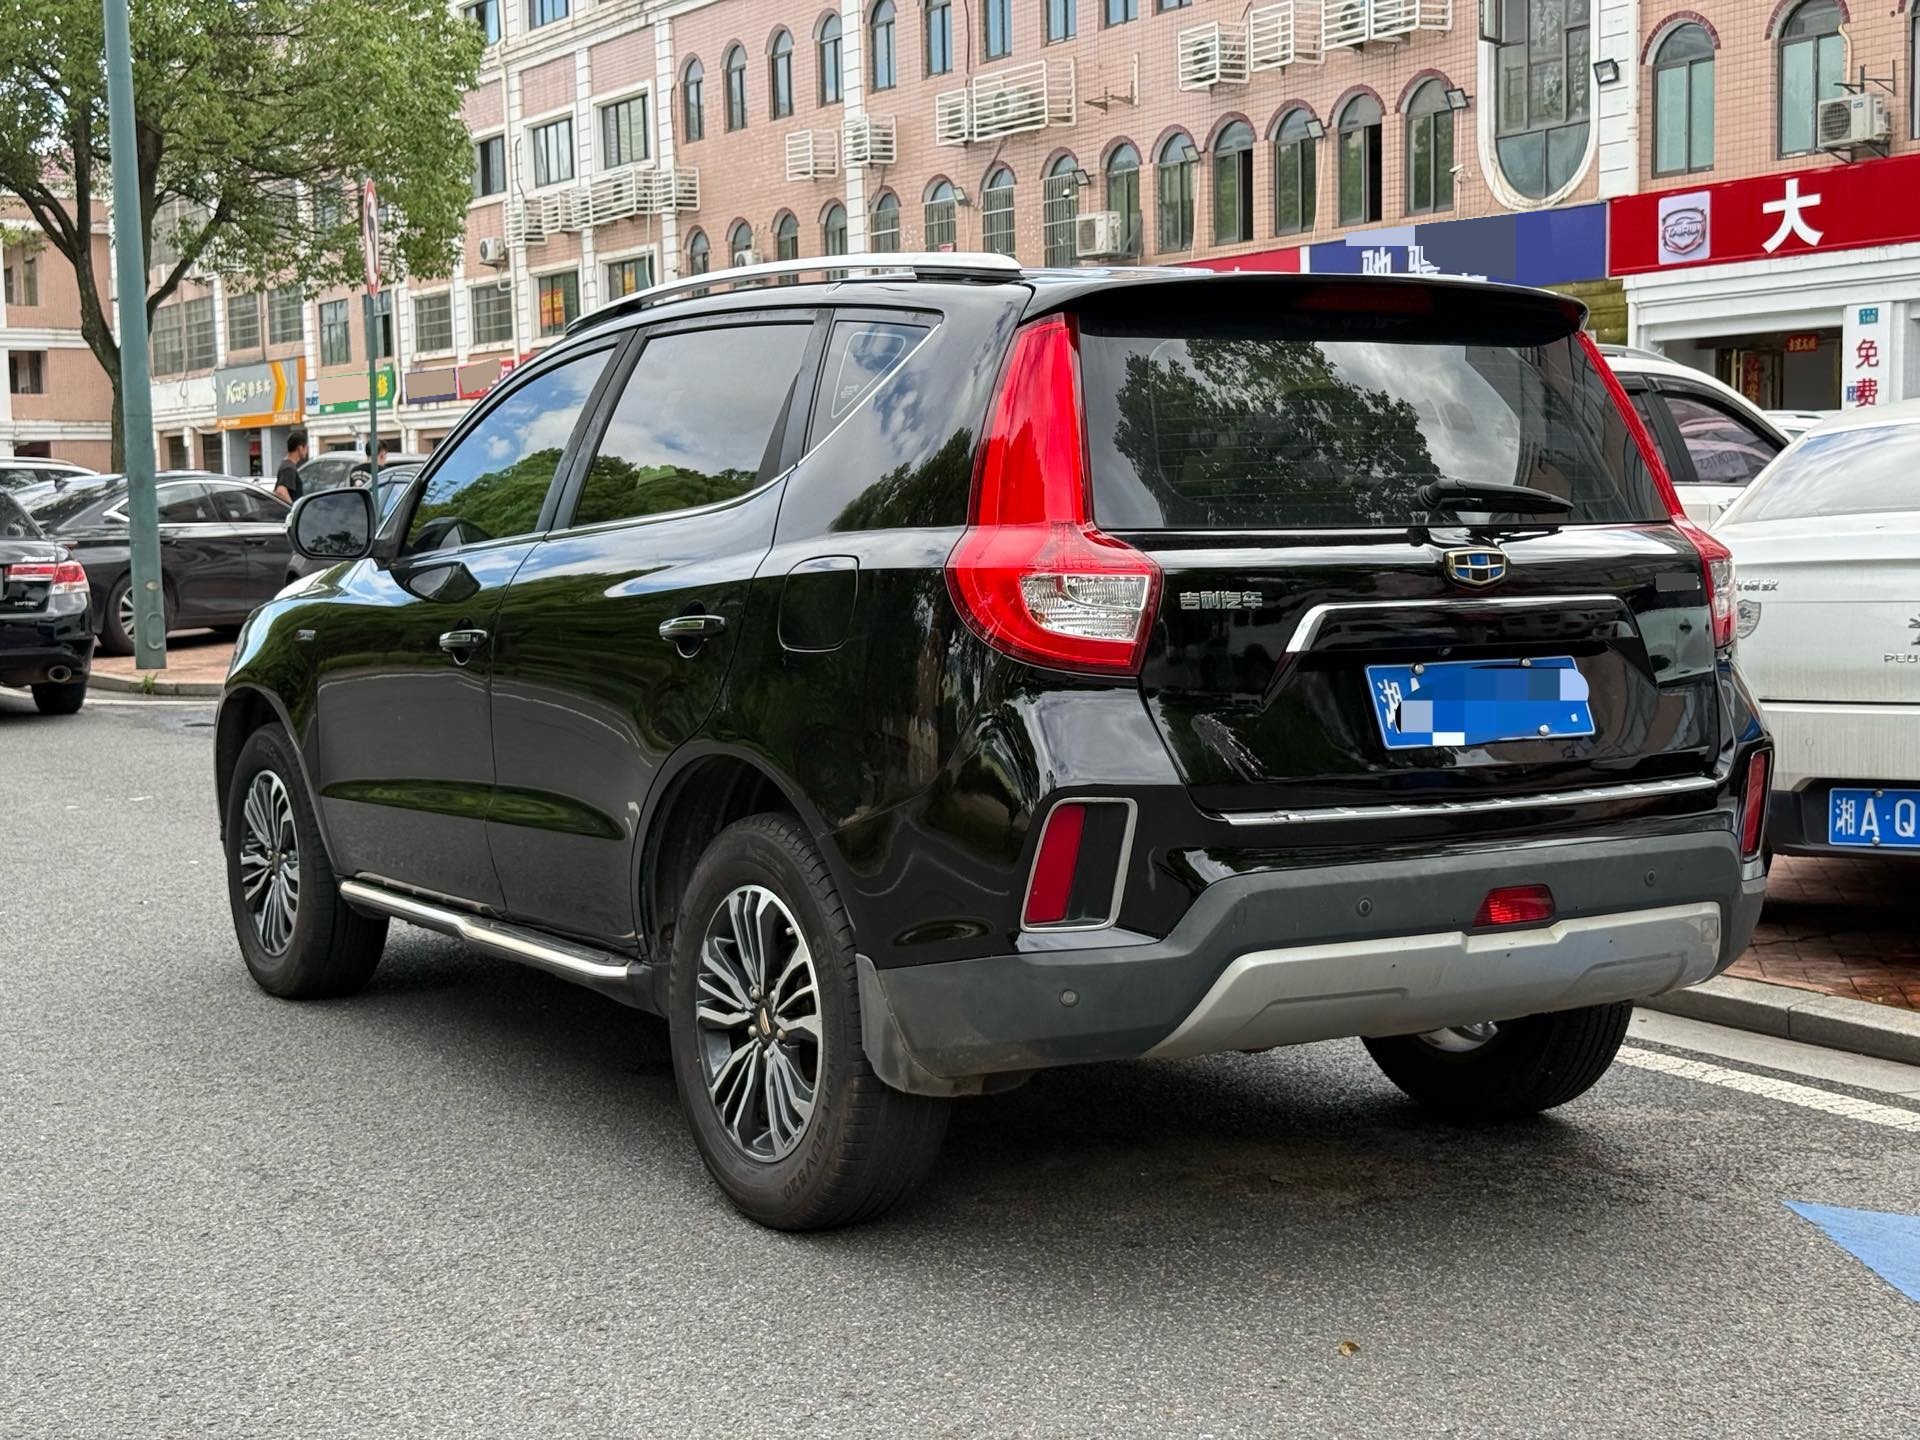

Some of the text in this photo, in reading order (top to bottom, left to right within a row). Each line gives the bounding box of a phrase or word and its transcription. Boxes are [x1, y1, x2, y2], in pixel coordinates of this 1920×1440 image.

[1761, 178, 1824, 254] 大
[1856, 339, 1879, 408] 免费
[1179, 590, 1263, 610] 吉利汽车
